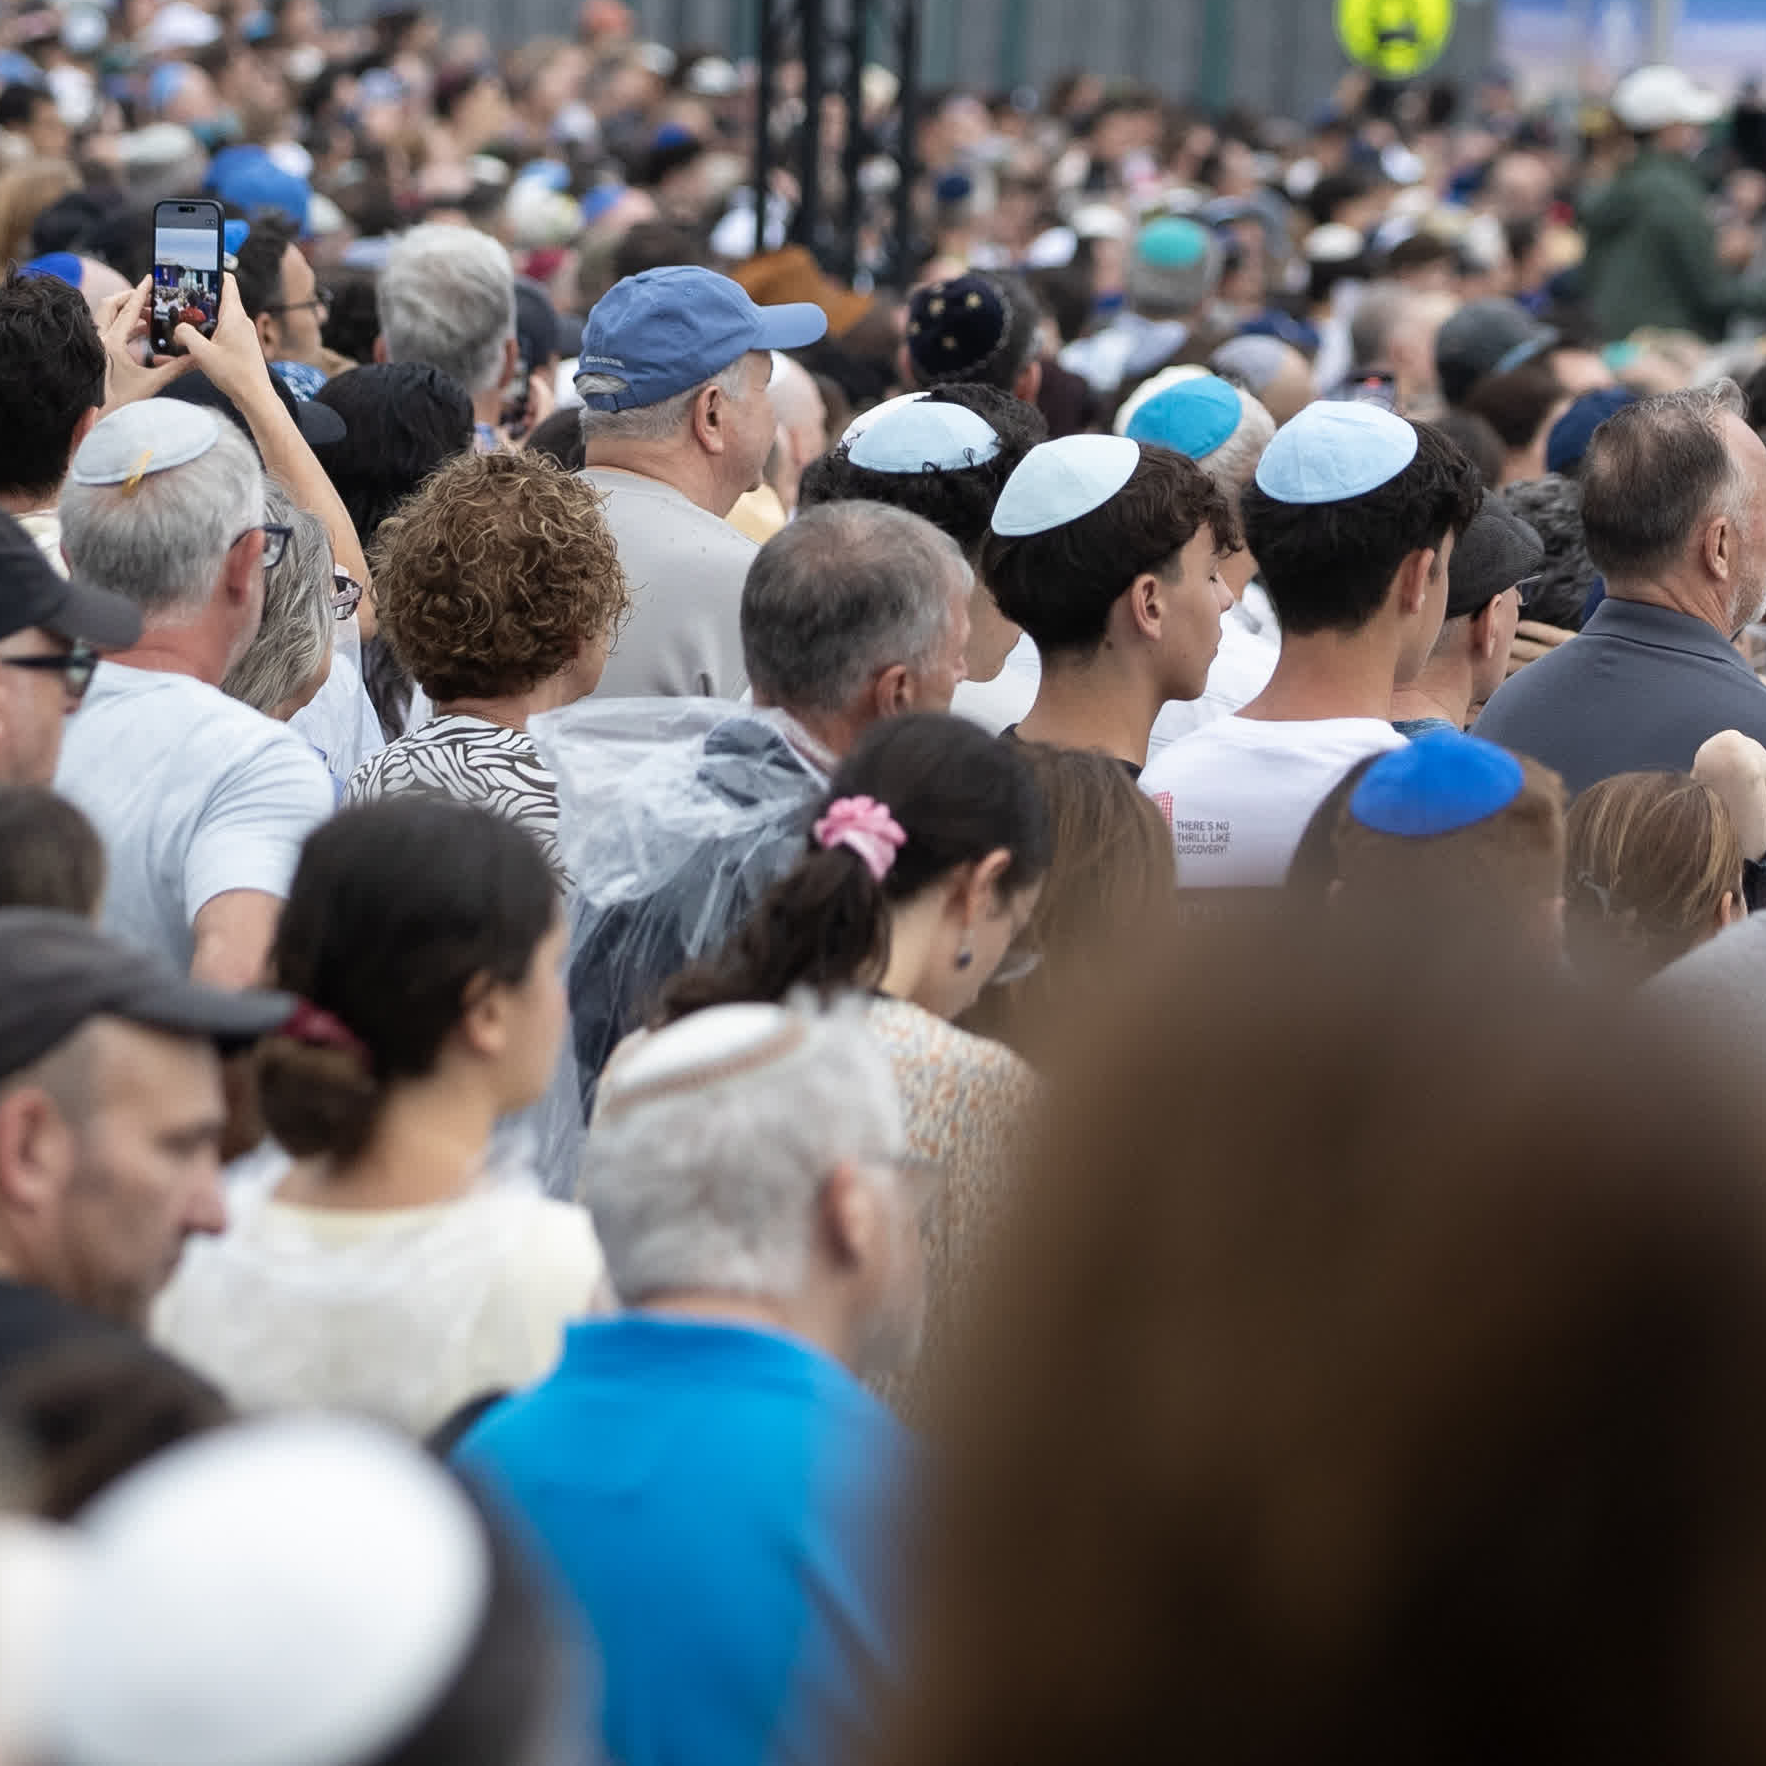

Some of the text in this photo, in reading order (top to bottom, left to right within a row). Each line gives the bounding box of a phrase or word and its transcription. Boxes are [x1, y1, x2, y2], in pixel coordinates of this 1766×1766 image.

[1176, 820, 1230, 832] THERE'S NO
[1177, 832, 1231, 843] THRILL LIKE
